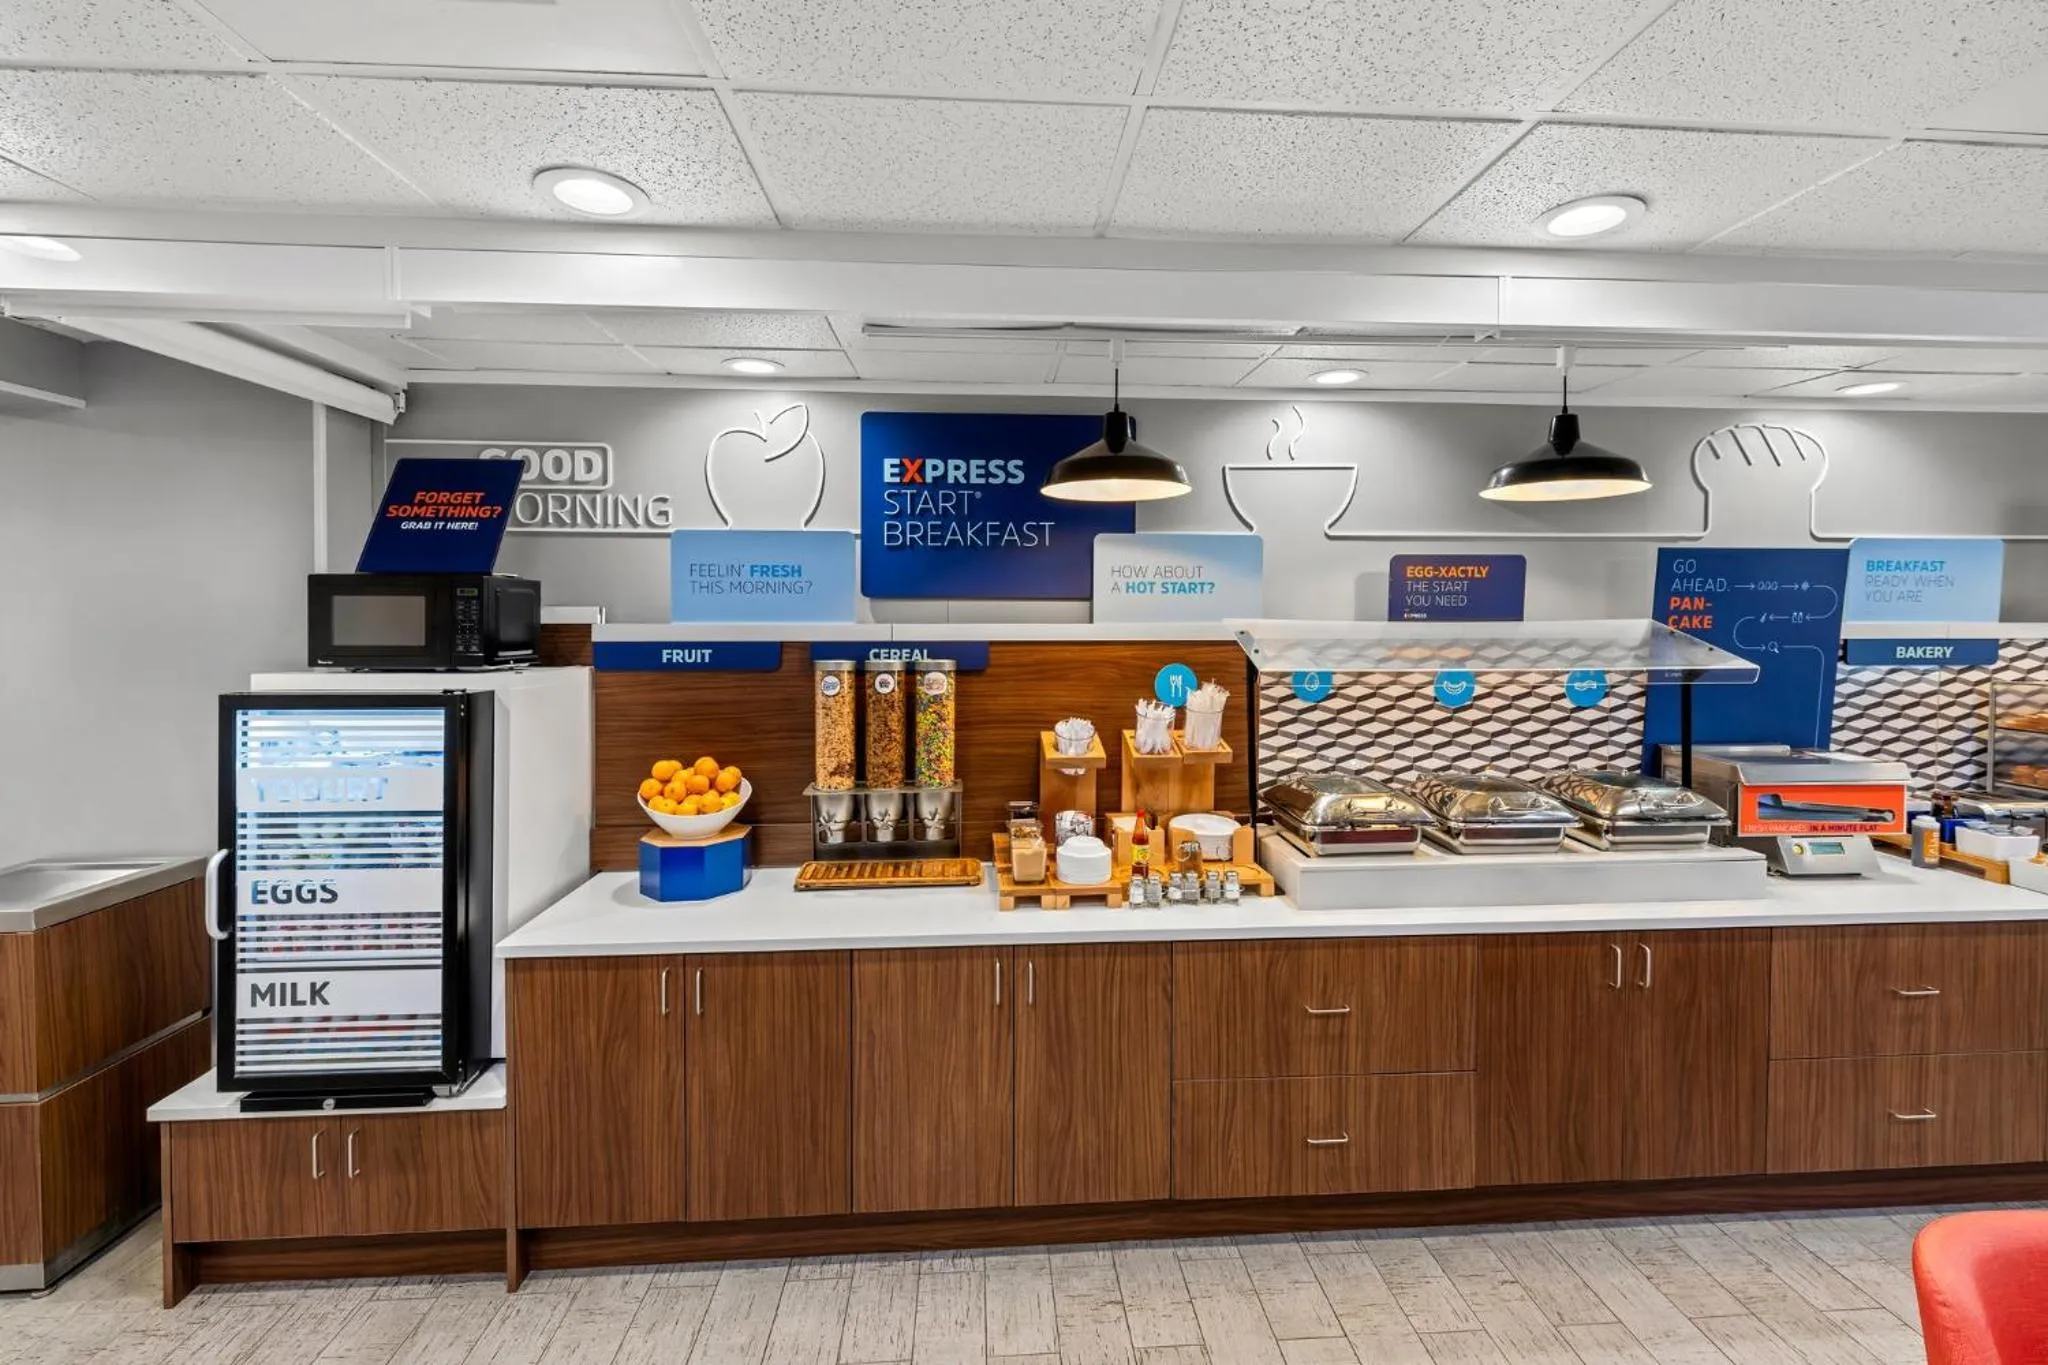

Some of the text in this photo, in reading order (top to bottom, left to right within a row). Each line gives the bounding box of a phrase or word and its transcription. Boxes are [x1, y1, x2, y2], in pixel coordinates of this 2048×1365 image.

[479, 448, 603, 482] OOD
[883, 457, 1026, 485] EXPRESS
[413, 491, 486, 504] FORGET
[385, 504, 503, 518] SOMETHING?
[515, 492, 674, 527] ORNING
[400, 520, 479, 530] GRAB IT HERE!
[883, 521, 1056, 547] BREAKFAST
[750, 564, 802, 578] FRESH
[1111, 565, 1204, 579] HOW ABOUT
[1406, 566, 1489, 578] EGG-XACTLY
[1673, 558, 1697, 574] GO
[1866, 560, 1946, 573] BREAKFAST
[691, 580, 813, 595] THIS MORNING?
[1111, 581, 1216, 595] A HOT START?
[1406, 580, 1469, 593] THE START
[1671, 578, 1731, 593] AHEAD.
[1864, 574, 1956, 588] READY WHEN
[1405, 594, 1468, 607] YOU NEED
[1865, 589, 1923, 603] YOU ARE
[1669, 597, 1713, 611] PAN-
[1668, 615, 1713, 630] CAKE
[662, 649, 713, 663] FRUIT
[869, 648, 931, 661] CEREAL
[1896, 646, 1954, 659] BAKERY
[1810, 824, 1819, 832] IN
[1820, 824, 1829, 832] A
[1830, 823, 1857, 832] MINUTE
[1860, 823, 1878, 832] FLAT
[250, 879, 339, 905] EGGS
[250, 981, 331, 1008] MILK
